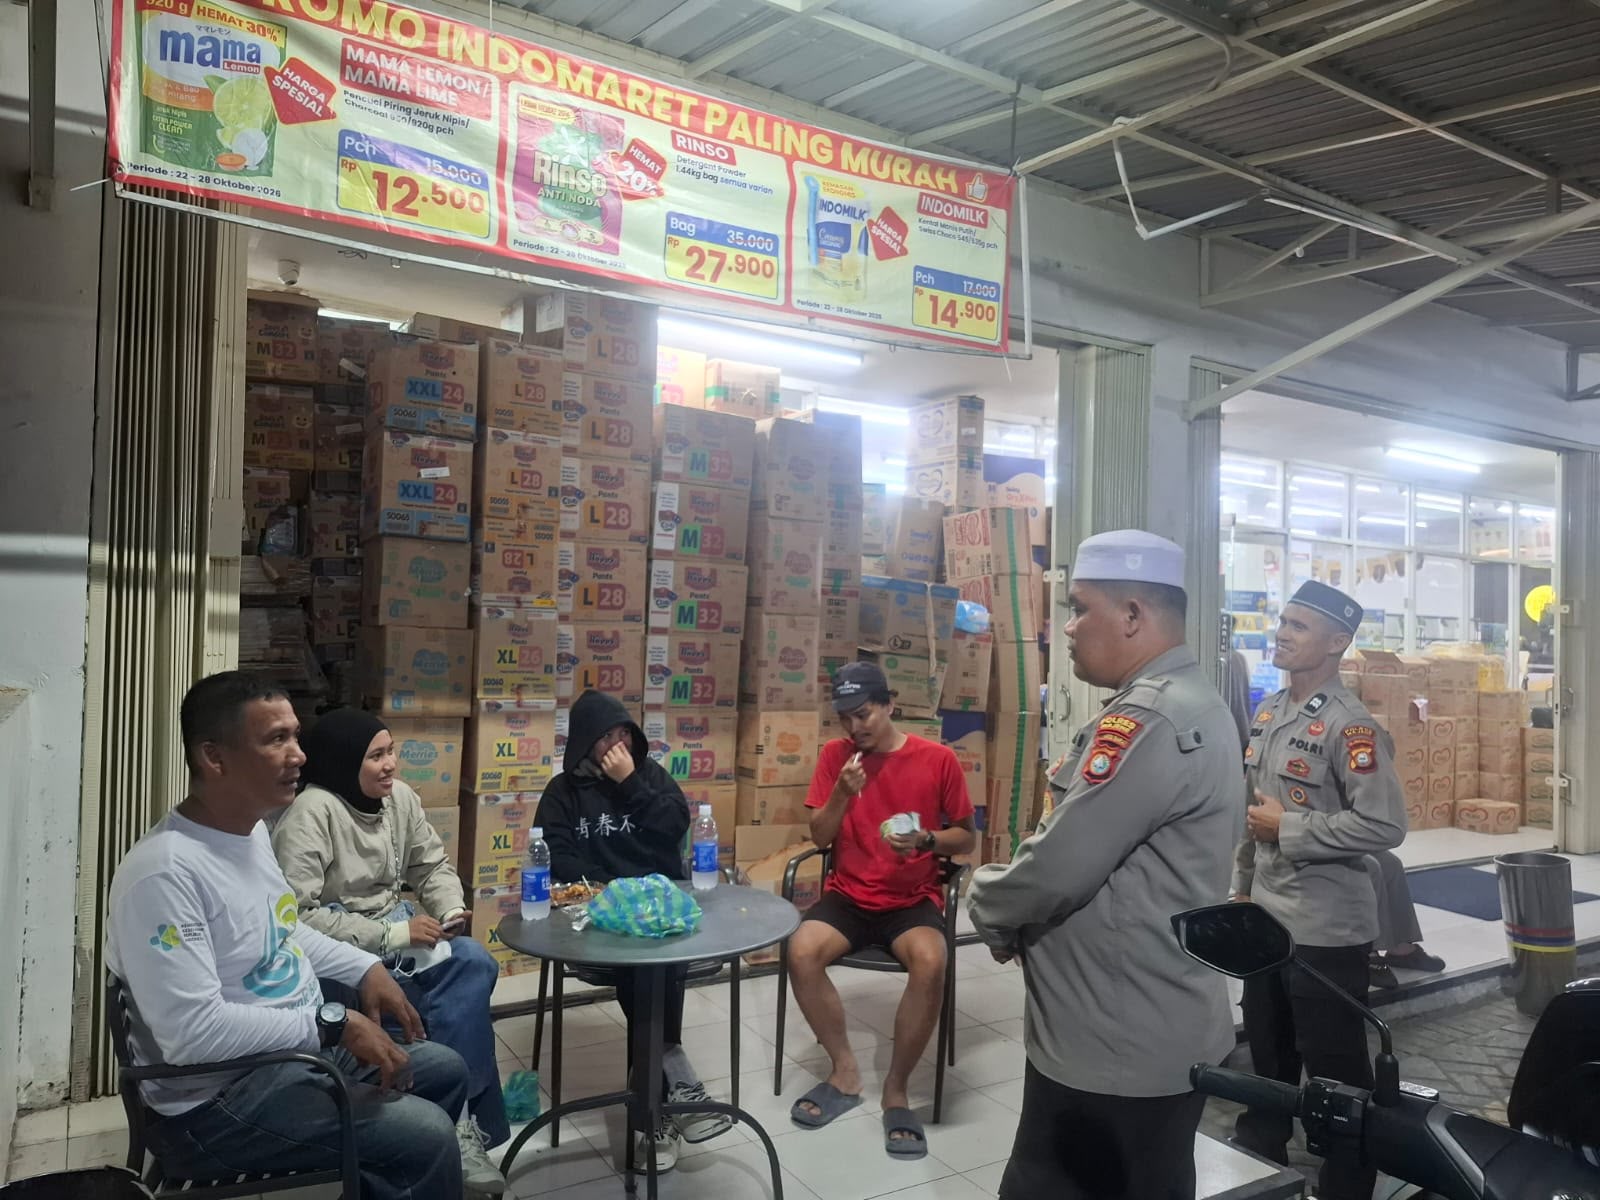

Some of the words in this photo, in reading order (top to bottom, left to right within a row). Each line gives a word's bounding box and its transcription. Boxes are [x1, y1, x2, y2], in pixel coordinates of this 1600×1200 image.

[178, 3, 189, 16] g
[197, 5, 244, 28] HEMAT
[245, 19, 278, 43] 30%
[159, 29, 262, 69] mama
[346, 44, 412, 75] MAMA
[223, 62, 260, 73] Lemon
[283, 67, 326, 103] HARGA
[344, 64, 412, 95] MAMA
[415, 81, 459, 107] LIME
[272, 75, 324, 118] SPESIAL
[437, 19, 699, 127] INDOMARET
[703, 101, 834, 165] PALING
[840, 141, 960, 194] MURAH
[344, 98, 388, 118] Charcoal
[435, 123, 455, 136] pch
[383, 99, 412, 116] Piring
[413, 107, 441, 121] Jeruk
[441, 112, 471, 128] Nipis/
[158, 124, 183, 135] CLEAN
[675, 133, 730, 160] RINSO
[340, 158, 357, 172] Rp
[344, 136, 377, 156] Pch
[423, 157, 482, 185] 15.000
[629, 145, 662, 175] HEMAT
[676, 154, 717, 171] Detergent
[176, 171, 189, 180] 22
[198, 175, 211, 184] 28
[213, 177, 256, 192] Oktober
[532, 151, 608, 198] Rinso
[618, 160, 659, 197] 20%
[675, 165, 702, 180] 1.44kg
[702, 170, 719, 184] bag
[719, 176, 747, 189] semua
[748, 181, 774, 195] varian
[371, 169, 485, 218] 12.500
[537, 187, 567, 201] ANTI
[568, 193, 602, 208] NODA
[818, 198, 867, 221] INDOMILK
[920, 195, 985, 224] INDOMILK
[670, 217, 696, 237] Bag
[726, 230, 774, 252] 35.000
[871, 225, 901, 255] SPESIAL
[877, 218, 902, 243] HARGA
[512, 239, 545, 251] Periode
[549, 246, 560, 255] 22
[667, 236, 680, 248] Rp
[684, 245, 775, 284] 27.900
[915, 271, 935, 285] Pch
[963, 280, 997, 298] 17.000
[928, 294, 996, 329] 14.900
[256, 342, 271, 355] M
[597, 338, 608, 358] L
[614, 341, 637, 363] 28
[407, 380, 441, 397] XXL
[443, 384, 462, 400] 24
[515, 383, 522, 397] L
[526, 385, 544, 400] 28
[600, 406, 620, 416] Pants
[251, 432, 265, 446] M
[591, 421, 601, 440] L
[607, 422, 632, 443] 28
[689, 451, 707, 473] M
[711, 455, 730, 473] 32
[510, 471, 518, 485] L
[522, 472, 540, 488] 28
[400, 483, 433, 499] XXL
[435, 487, 455, 502] 24
[598, 490, 619, 498] Pants
[589, 505, 601, 524] L
[606, 506, 630, 527] 28
[681, 528, 698, 549] M
[702, 531, 722, 550] 32
[503, 550, 522, 566] 28
[525, 552, 534, 566] L
[592, 572, 613, 580] Pants
[583, 587, 593, 606] L
[599, 588, 624, 607] 28
[689, 591, 710, 599] Pants
[677, 605, 695, 624] M
[698, 607, 720, 624] 32
[1220, 614, 1229, 653] TARIK
[496, 649, 517, 664] XL
[520, 650, 541, 665] 26
[583, 670, 594, 688] L
[599, 669, 623, 688] 28
[683, 666, 704, 674] Pants
[671, 681, 689, 699] M
[693, 682, 713, 699] 32
[398, 749, 439, 760] Merries
[495, 742, 516, 758] XL
[519, 742, 539, 757] 26
[1288, 736, 1324, 756] POLRI
[670, 756, 688, 775] M
[691, 757, 713, 773] 32
[492, 834, 512, 850] XL
